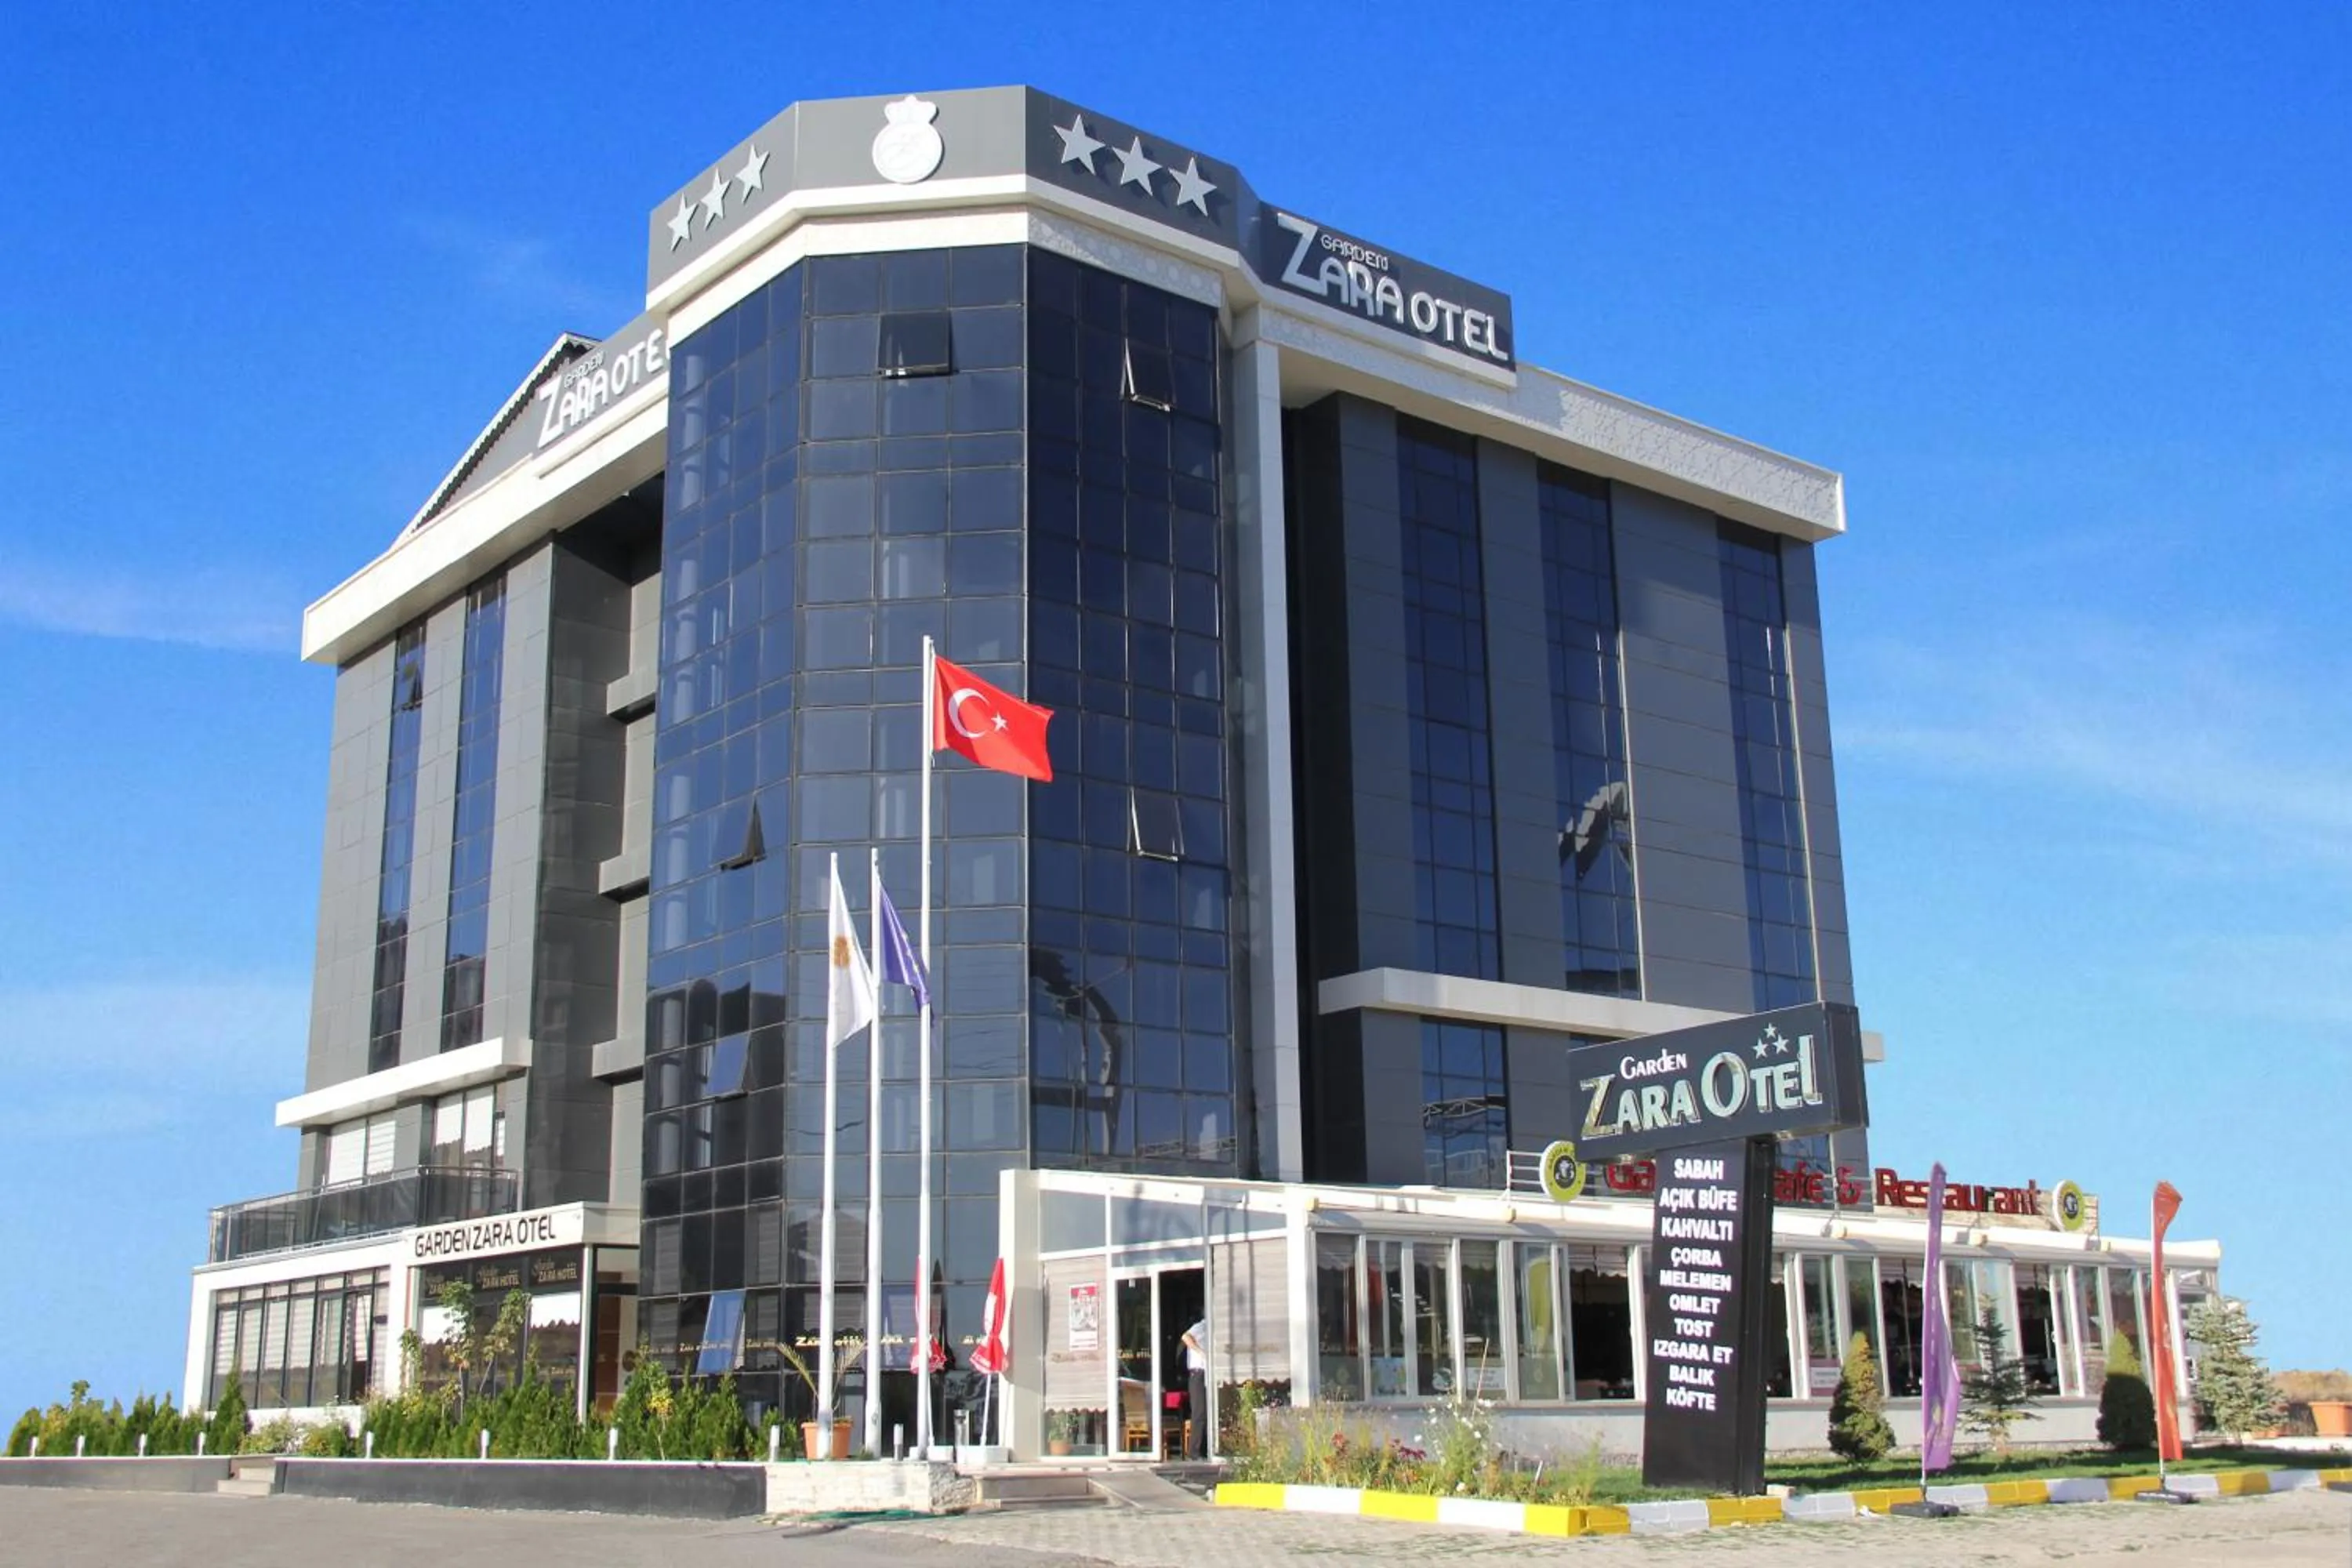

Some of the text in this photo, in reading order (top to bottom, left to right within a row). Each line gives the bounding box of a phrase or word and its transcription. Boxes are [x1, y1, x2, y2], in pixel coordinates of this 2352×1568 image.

[1320, 234, 1389, 271] GARDEN
[1277, 212, 1509, 361] ZARA OTEL
[538, 369, 608, 448] ZARA
[1580, 1034, 1823, 1140] ZARA OTEL
[1674, 1158, 1724, 1181] SABAH
[1660, 1185, 1737, 1213] AÇIK BÜFE
[1773, 1160, 1825, 1203] afe
[1875, 1167, 2040, 1215] Resaurant
[415, 1214, 556, 1258] GARDEN ZARA OTEL
[1661, 1217, 1733, 1241] KAHVALTI
[1671, 1247, 1722, 1268] ÇORBA
[1669, 1294, 1722, 1316] OMLET
[1675, 1318, 1715, 1339] TOST
[1654, 1339, 1733, 1364] IZGARA ET
[1669, 1364, 1715, 1386] BALIK
[1666, 1387, 1716, 1411] KÖFTE
